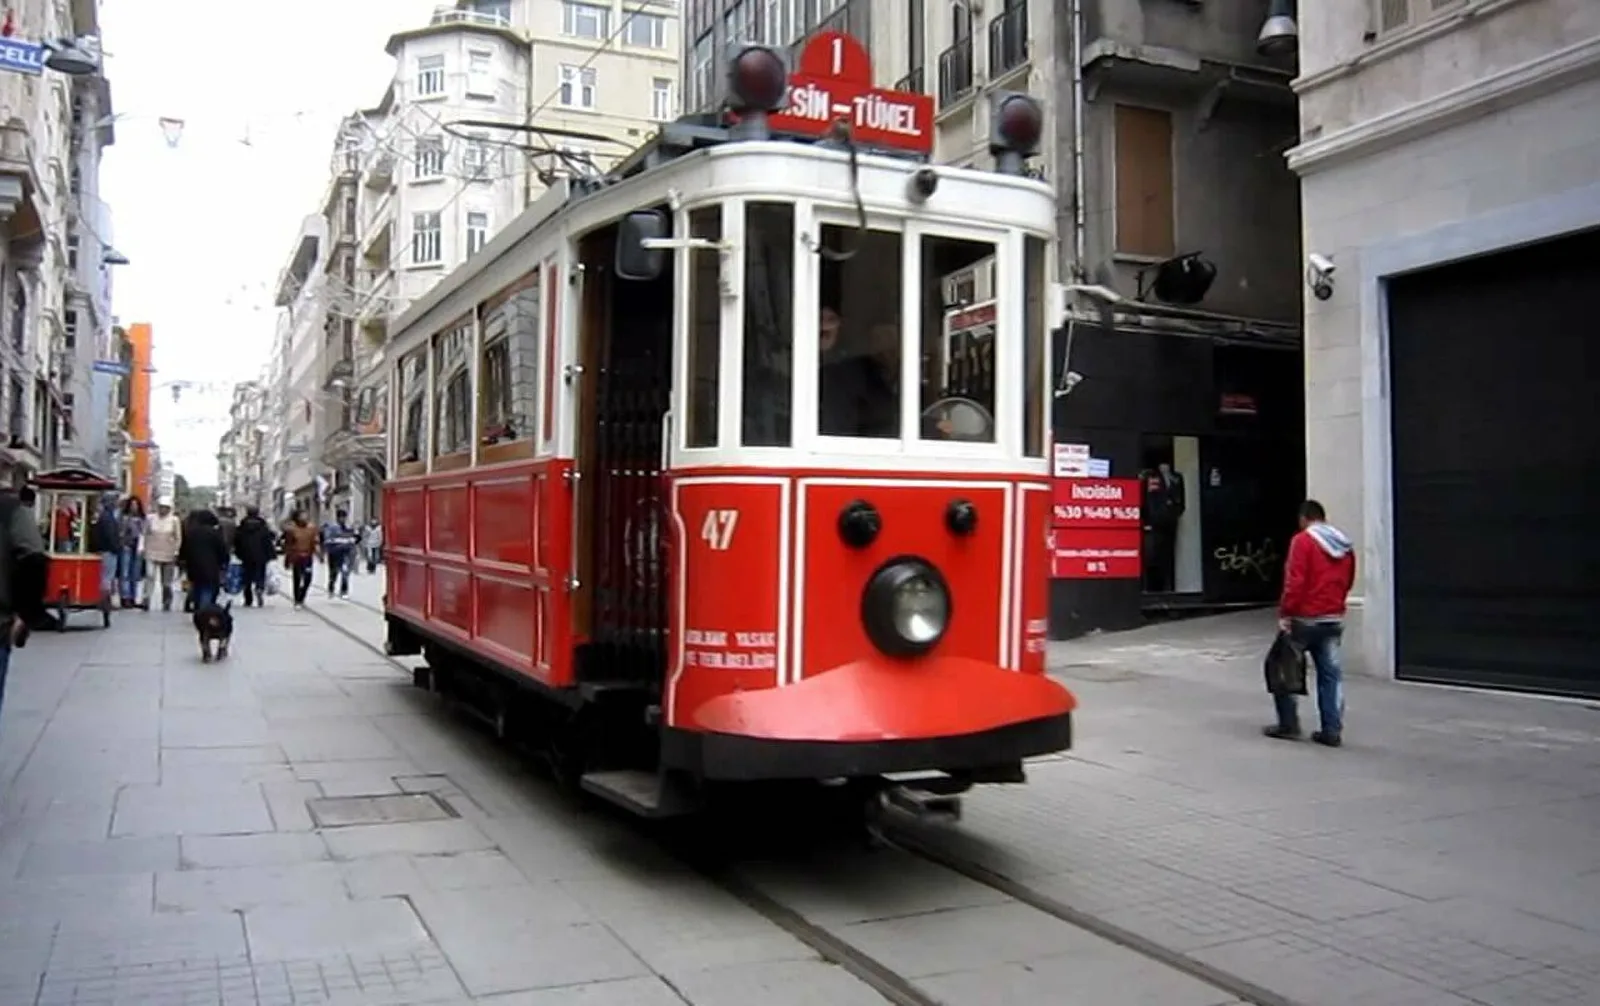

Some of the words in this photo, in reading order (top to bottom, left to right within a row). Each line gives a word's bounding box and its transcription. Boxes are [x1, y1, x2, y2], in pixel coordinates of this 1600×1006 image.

[832, 38, 842, 75] 1
[781, 83, 830, 121] SİM
[853, 94, 922, 137] TÜNEL
[1071, 483, 1123, 500] İNDİRİM
[701, 509, 739, 550] 47
[1053, 505, 1082, 519] %30
[1083, 505, 1112, 520] %40
[1113, 506, 1140, 520] %50
